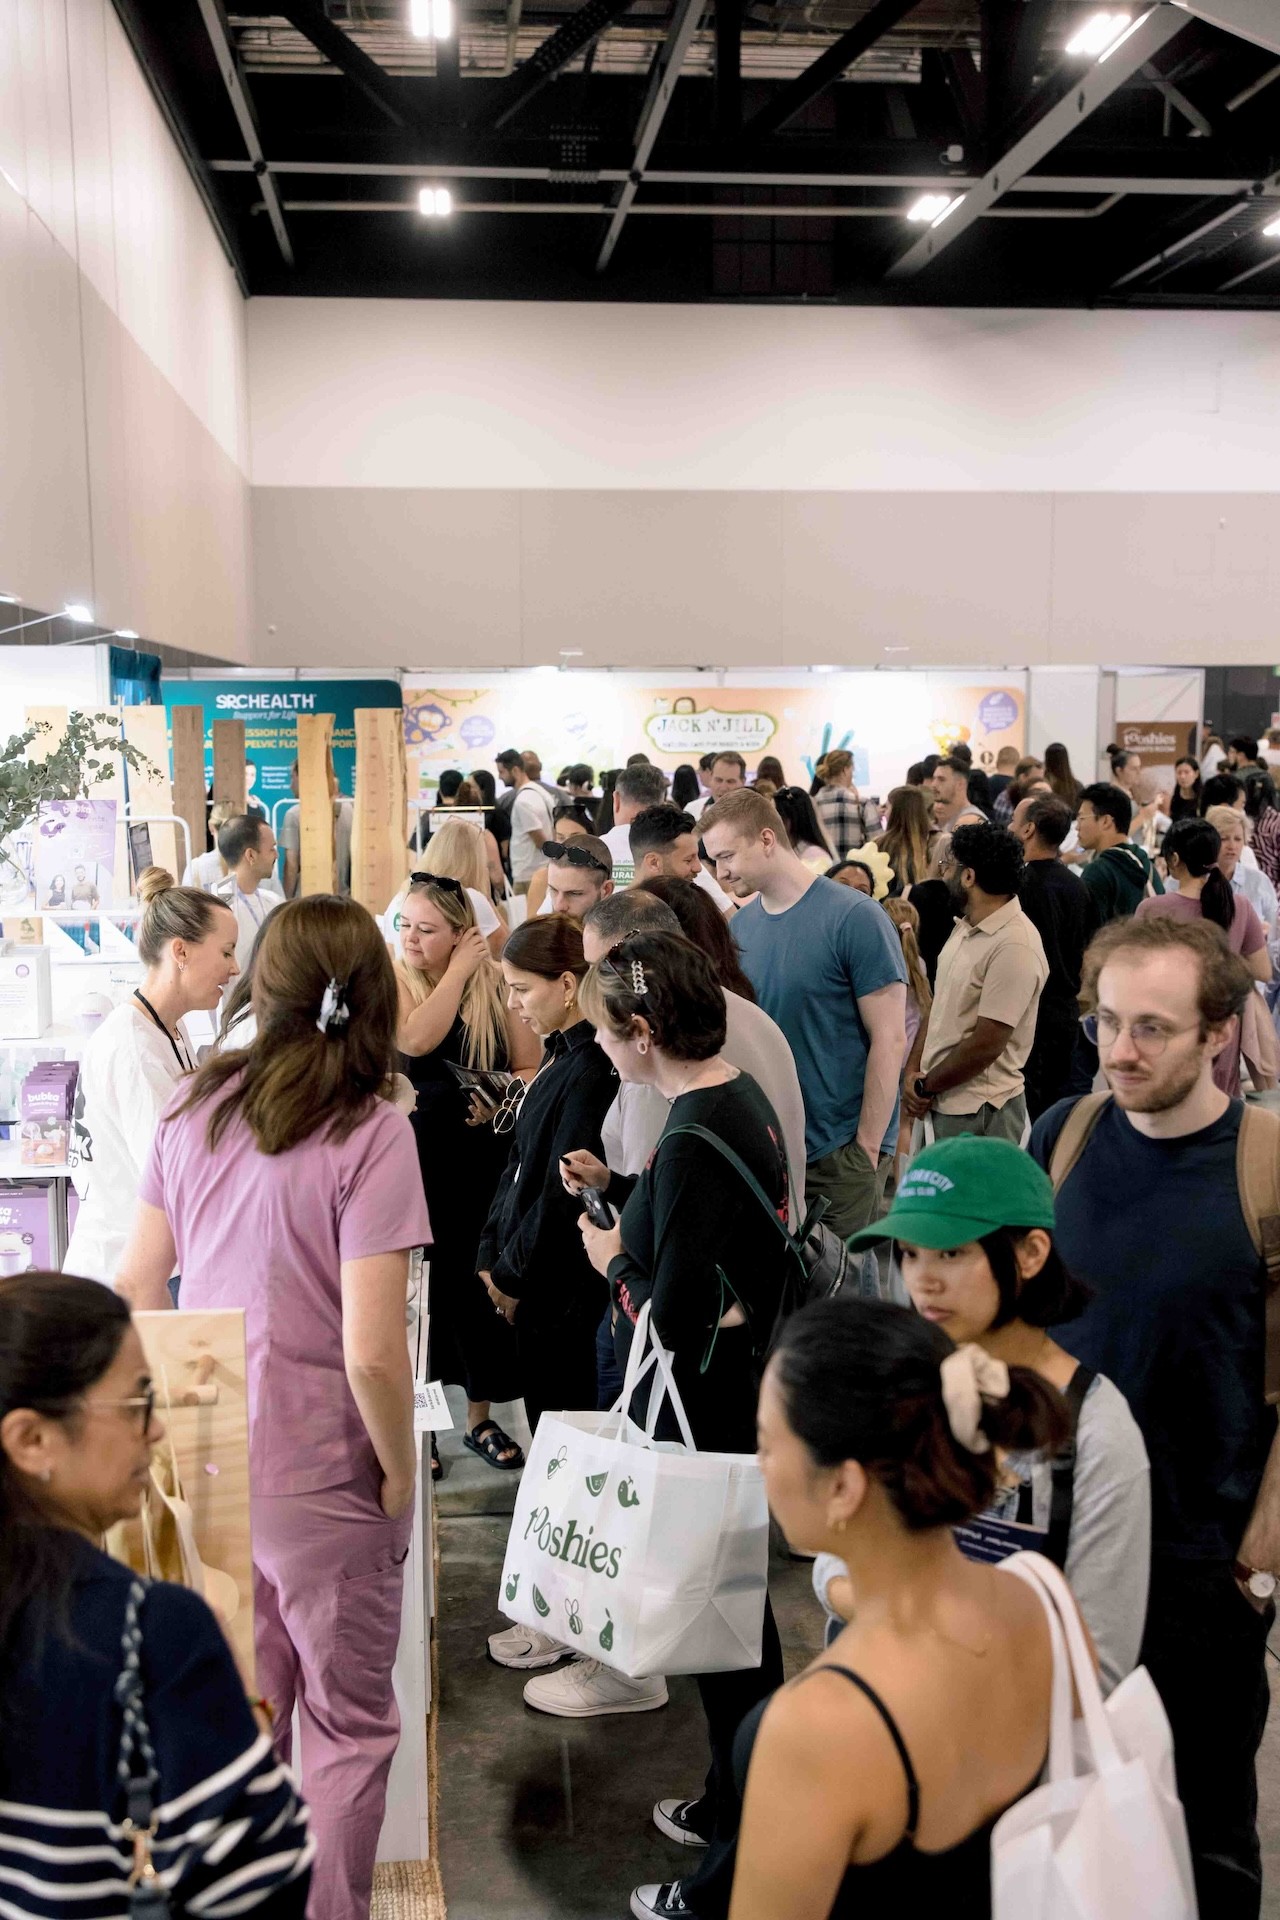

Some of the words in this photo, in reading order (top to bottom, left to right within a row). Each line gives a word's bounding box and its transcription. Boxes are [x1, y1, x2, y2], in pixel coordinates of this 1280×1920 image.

[657, 718, 702, 733] JACK
[722, 718, 766, 733] JILL
[523, 1505, 623, 1580] Poshies
